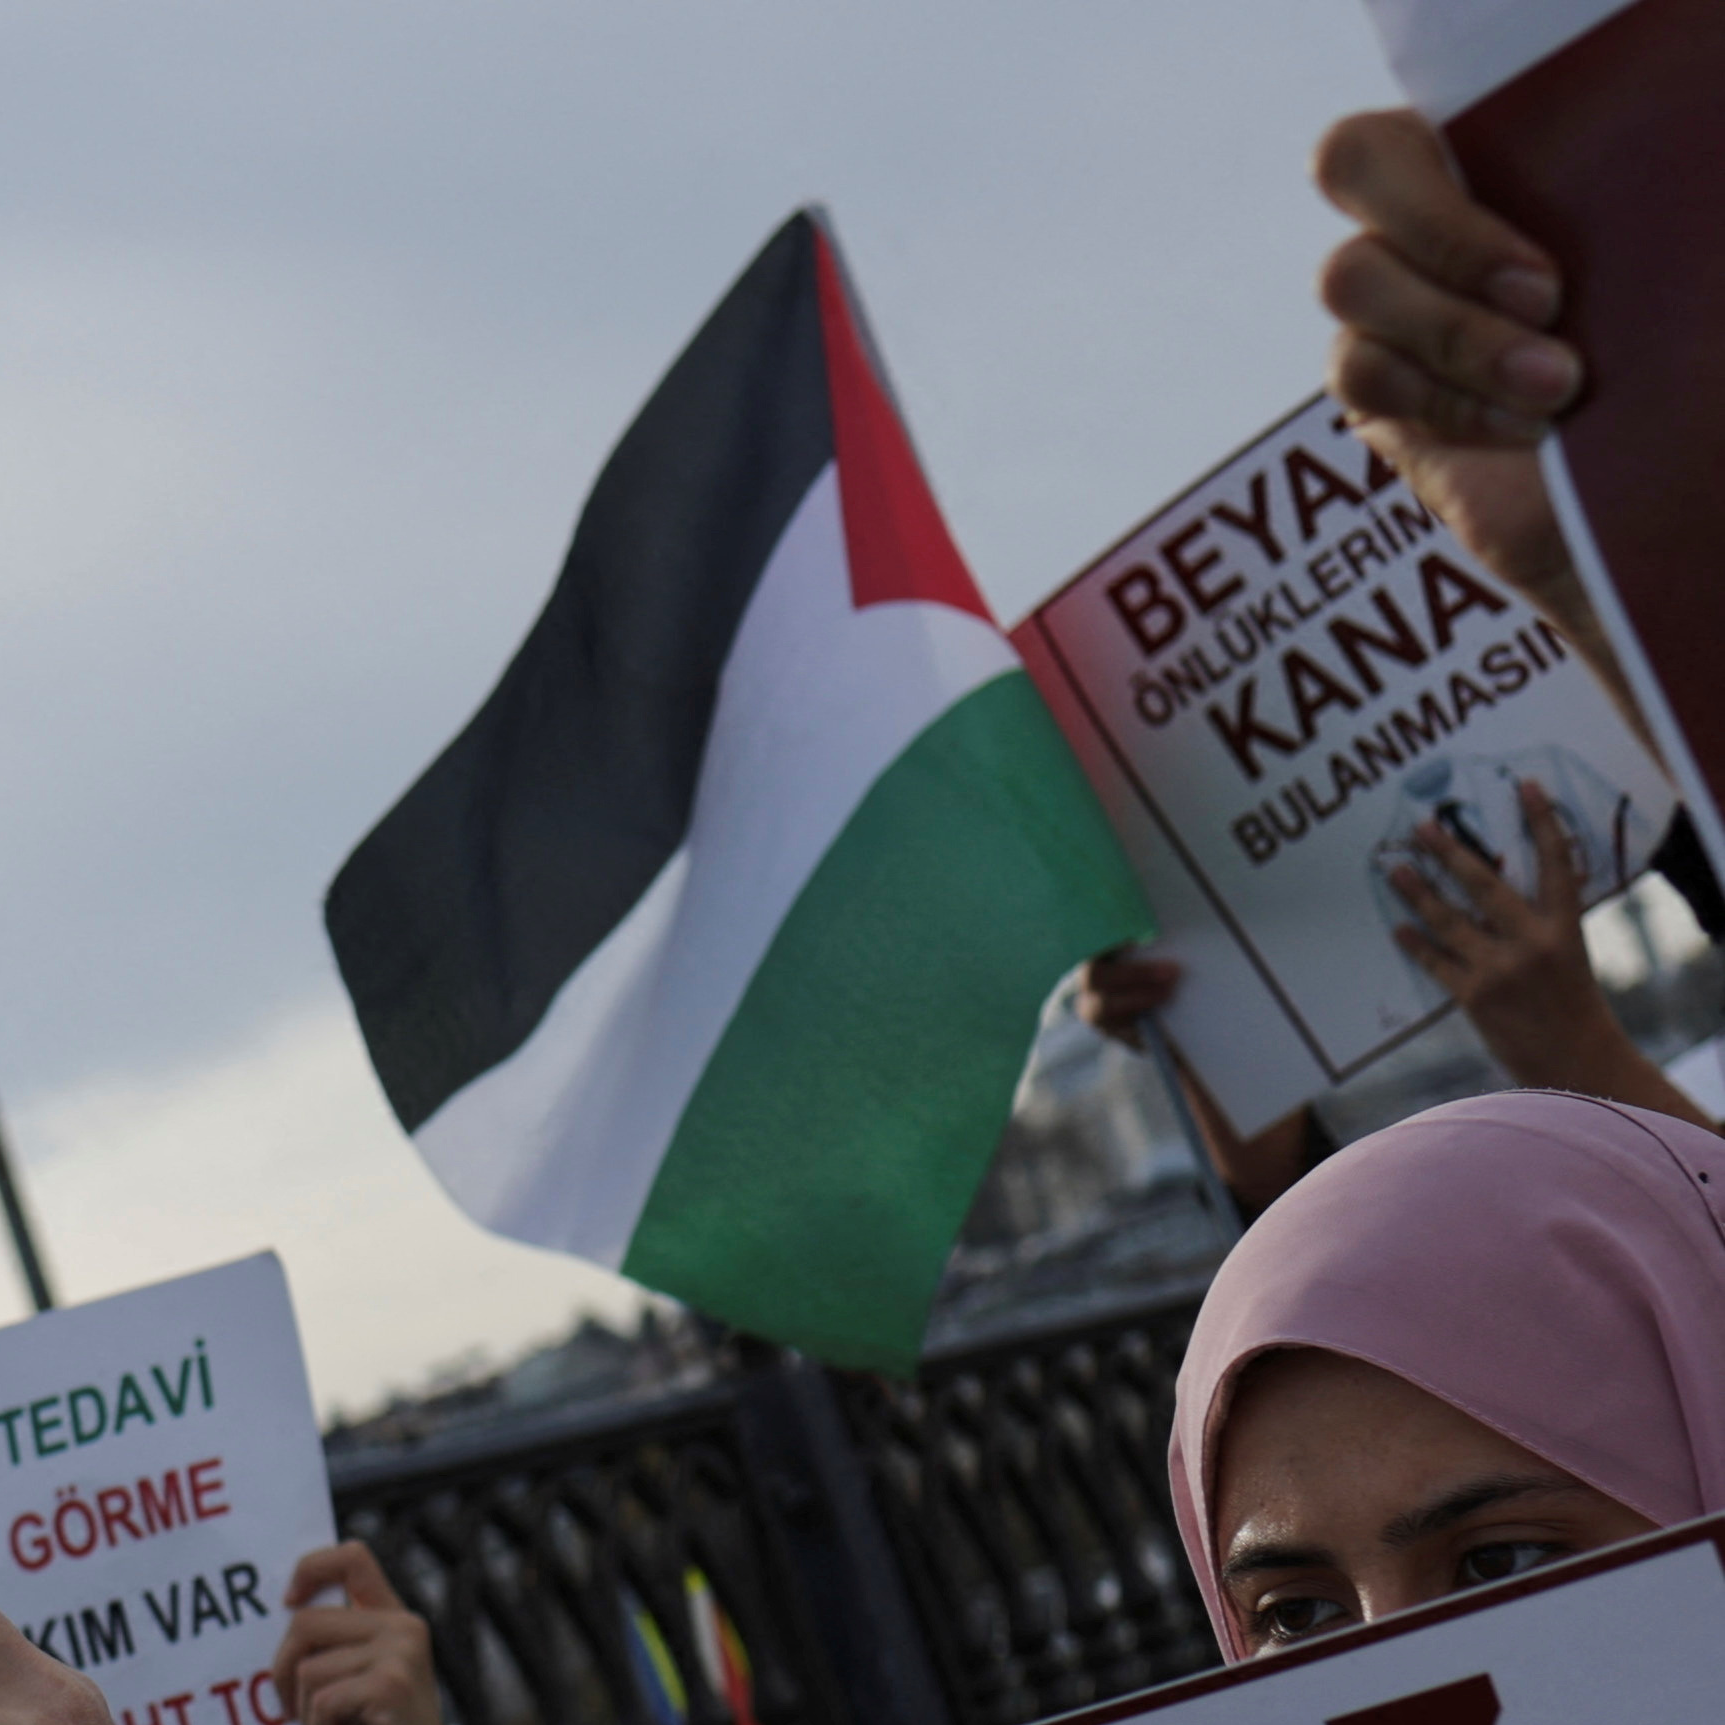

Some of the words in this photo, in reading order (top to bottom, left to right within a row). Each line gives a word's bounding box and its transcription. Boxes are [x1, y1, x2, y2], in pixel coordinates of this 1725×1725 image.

[1206, 550, 1511, 782] KANA
[8, 1458, 231, 1572] GÖRME
[143, 1561, 268, 1645] VAR
